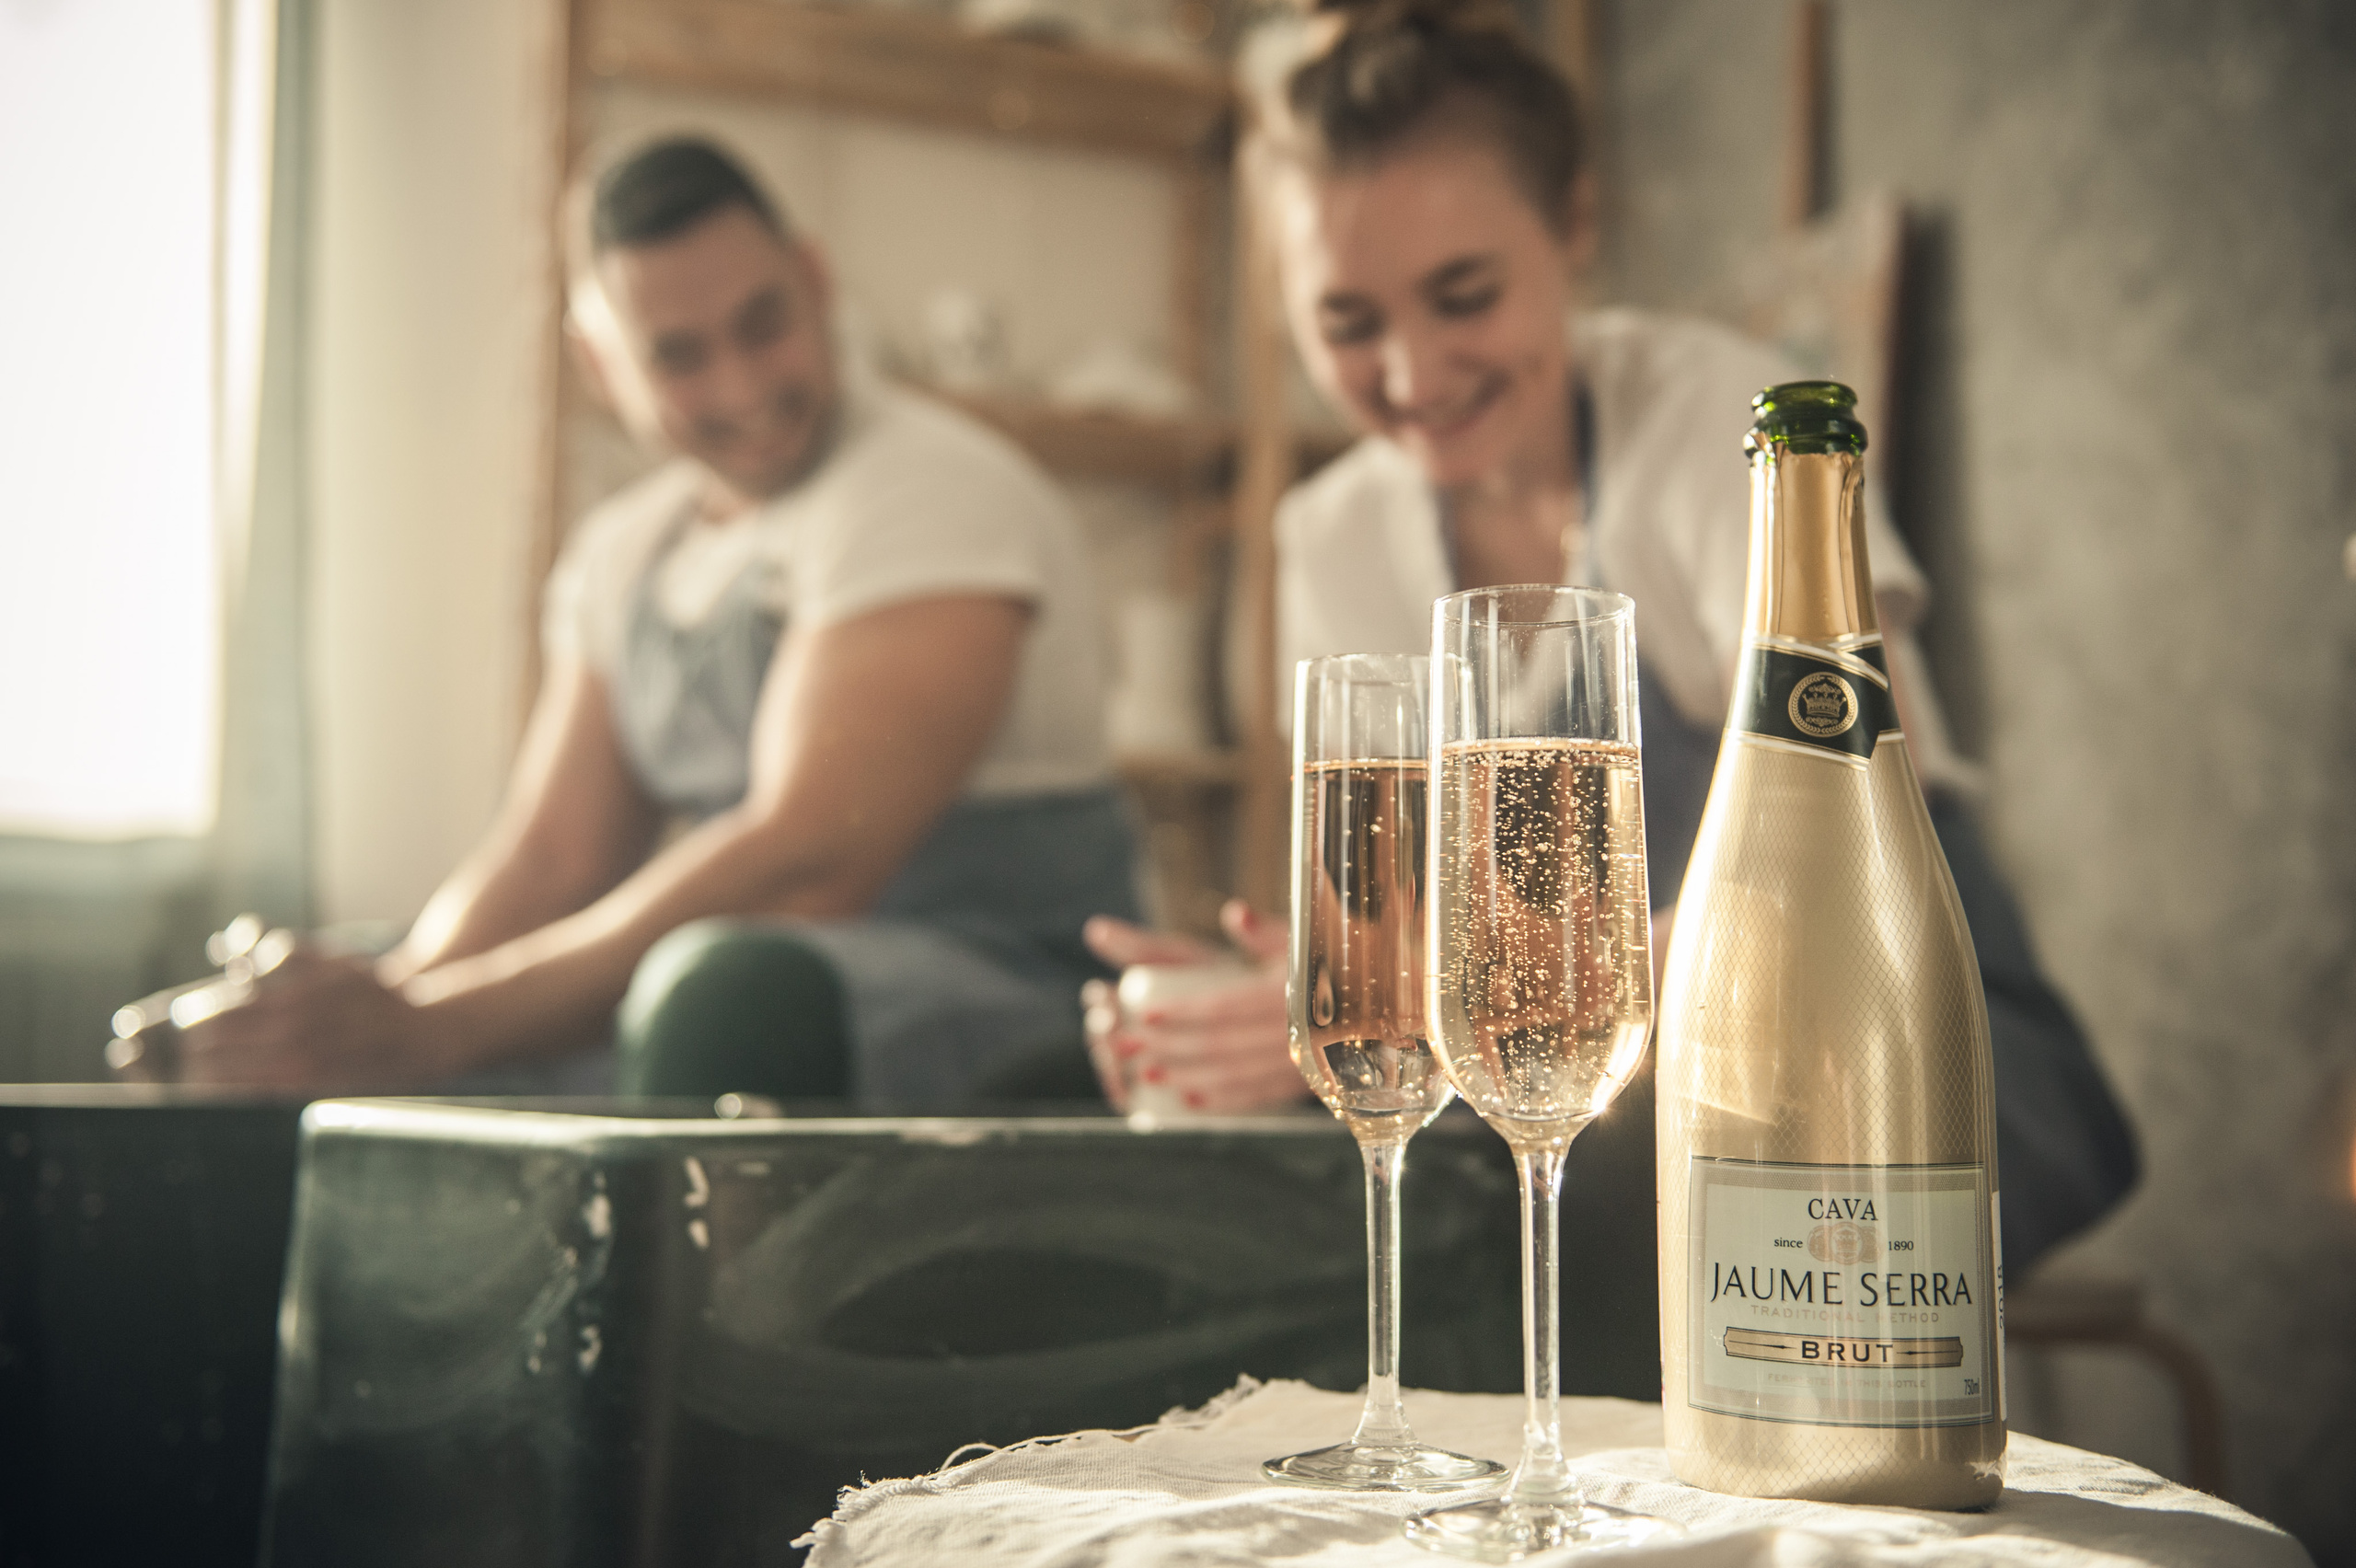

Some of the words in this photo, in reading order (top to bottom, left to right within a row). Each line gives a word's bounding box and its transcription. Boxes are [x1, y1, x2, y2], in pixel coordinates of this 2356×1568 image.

[1807, 1198, 1879, 1221] CAVA
[1773, 1237, 1803, 1248] since
[1888, 1240, 1914, 1251] 1890
[1710, 1262, 1843, 1306] JAUME
[1860, 1271, 1973, 1307] SERRA
[1750, 1304, 1865, 1322] TRADITIONAL
[1801, 1340, 1894, 1363] BRUT
[1964, 1377, 1980, 1396] 750ml
